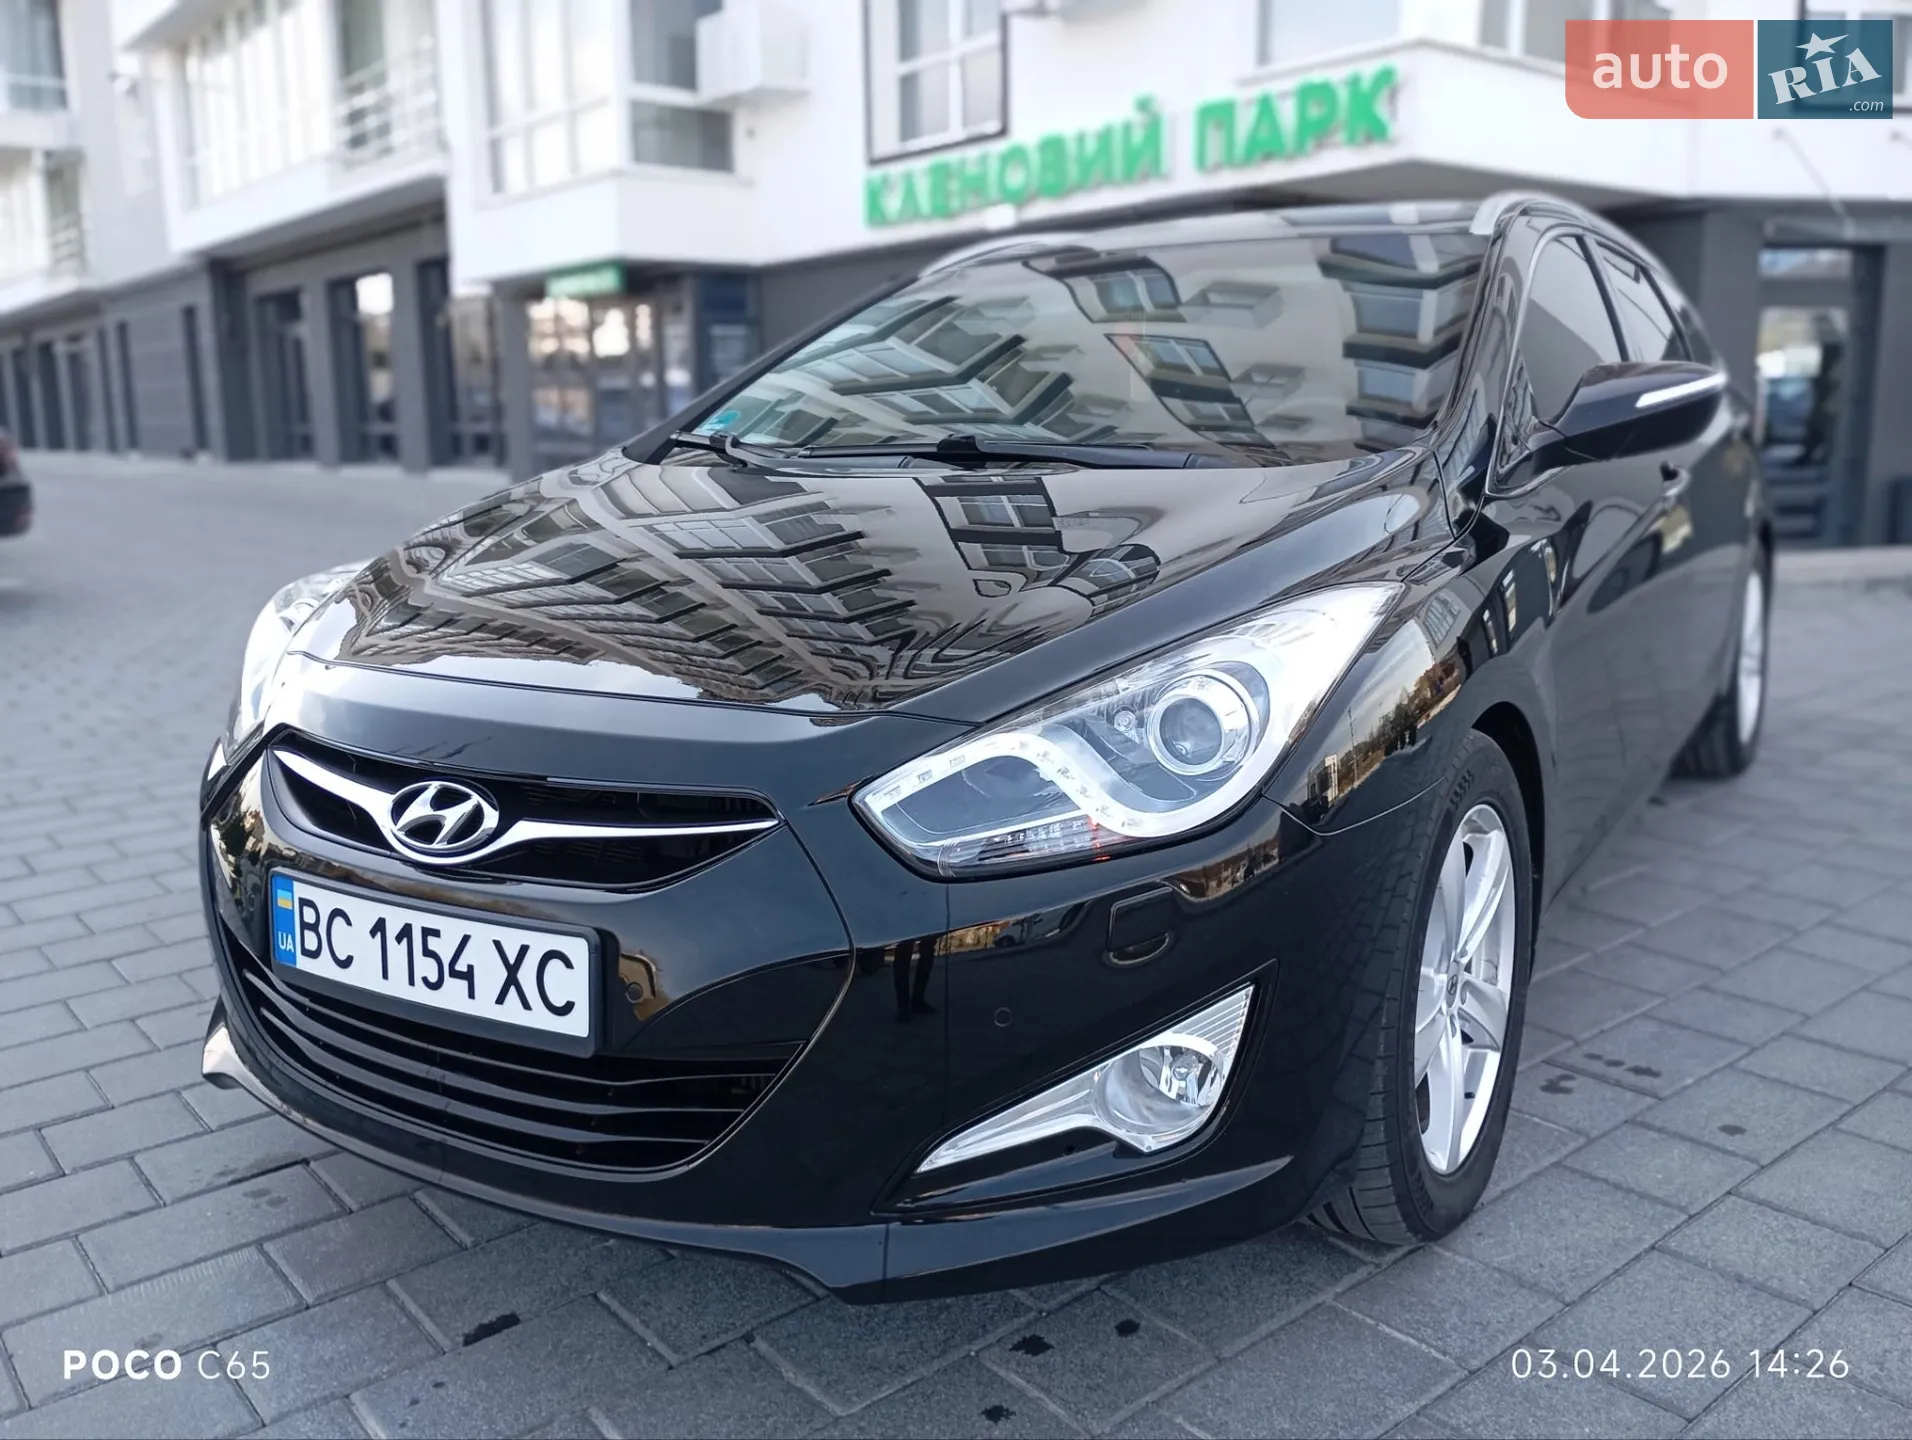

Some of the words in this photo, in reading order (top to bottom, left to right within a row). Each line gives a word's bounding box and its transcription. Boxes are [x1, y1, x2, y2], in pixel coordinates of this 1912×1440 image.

[866, 95, 1167, 227] КЛЕНОВИЙ
[1195, 65, 1398, 172] ПАРК
[278, 931, 295, 953] UA
[298, 897, 354, 970] BC
[369, 917, 476, 1001] 1154
[492, 939, 576, 1017] XC
